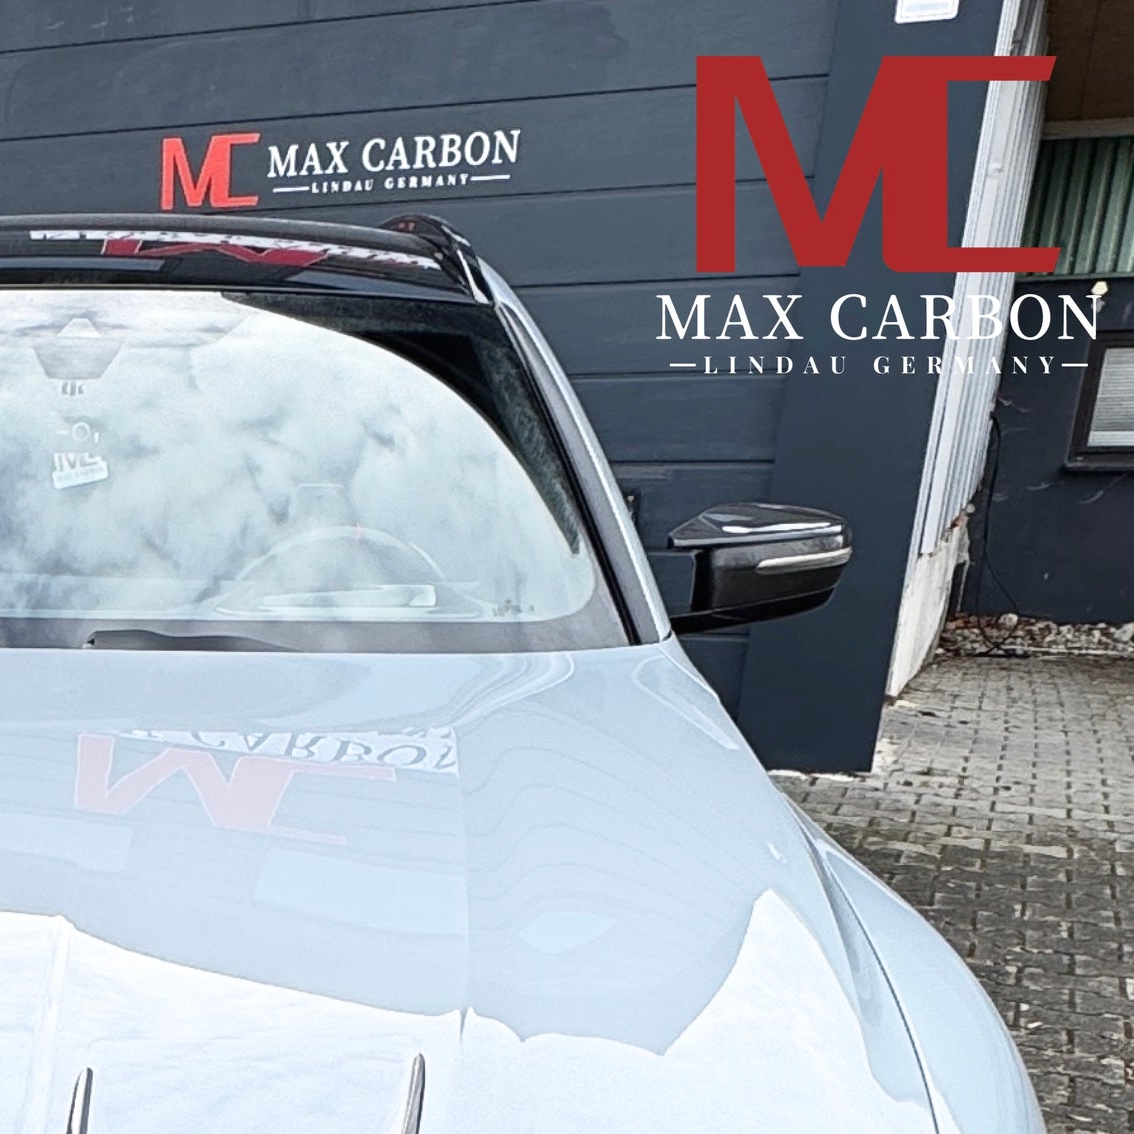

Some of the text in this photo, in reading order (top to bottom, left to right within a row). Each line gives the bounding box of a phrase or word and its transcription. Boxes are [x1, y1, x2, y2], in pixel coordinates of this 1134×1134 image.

[160, 132, 261, 211] MC
[267, 128, 521, 178] MAX CARBON
[311, 173, 469, 194] LINDAU GERMANY
